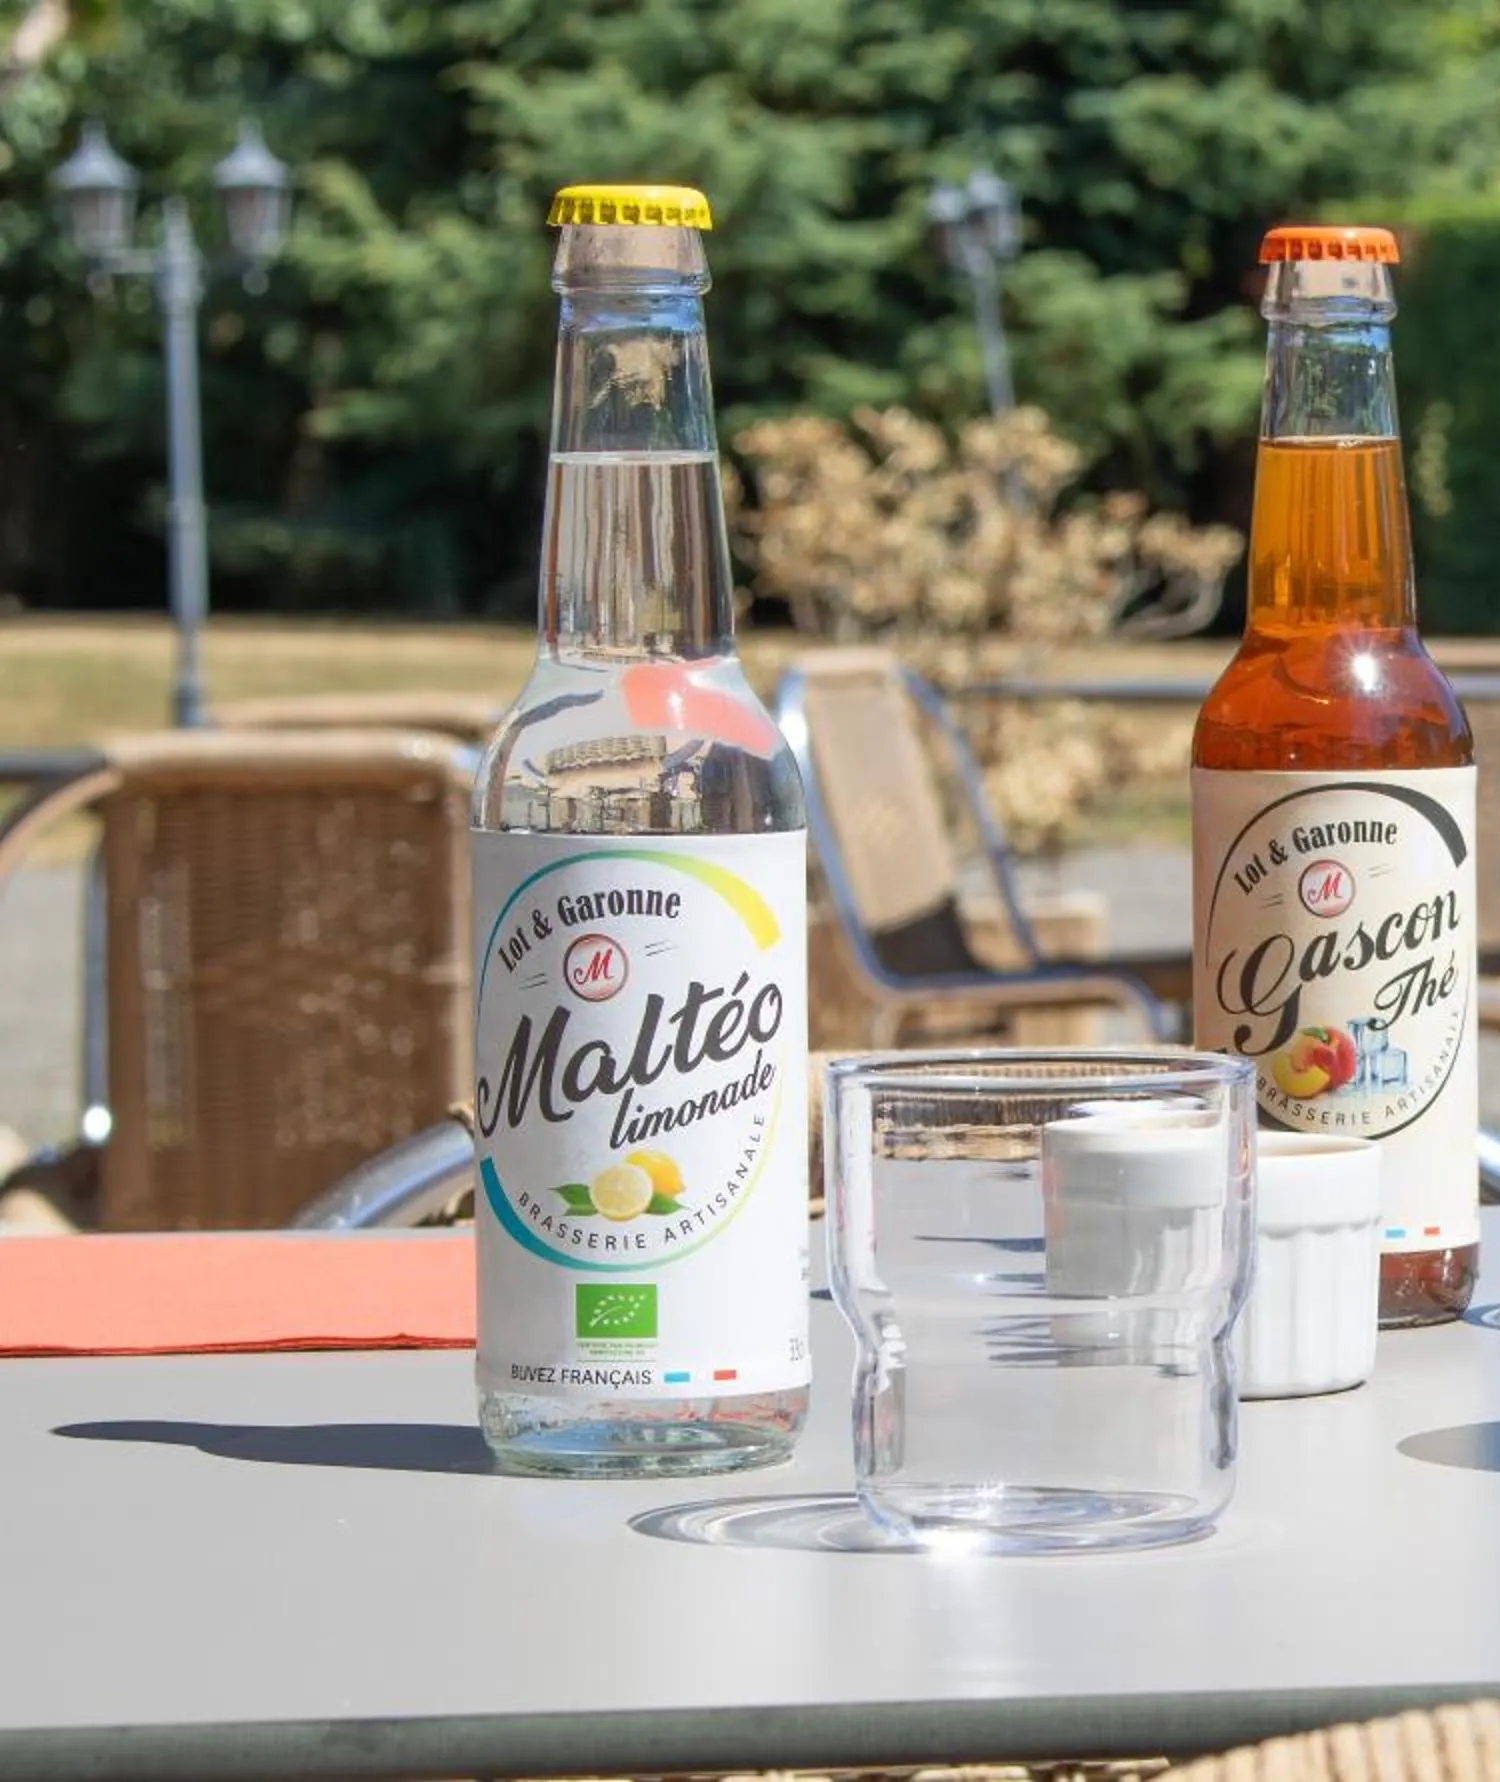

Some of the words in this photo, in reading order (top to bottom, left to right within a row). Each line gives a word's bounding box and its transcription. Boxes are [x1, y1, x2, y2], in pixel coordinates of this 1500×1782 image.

[1234, 853, 1268, 896] Lot
[1268, 839, 1289, 866] &
[1291, 819, 1398, 855] Garonne
[1307, 870, 1343, 904] M
[498, 926, 533, 973] Lot
[531, 909, 553, 940] &
[557, 888, 682, 928] Garonne
[573, 948, 615, 985] M
[1216, 889, 1461, 1056] Gascon
[1367, 950, 1458, 1032] Thé
[477, 970, 783, 1139] Maltéo
[609, 1048, 775, 1150] limonade
[1257, 1074, 1372, 1127] BRASSERIE
[517, 1191, 647, 1251] BRASSERIE
[664, 1113, 766, 1245] ARTISANALE
[511, 1363, 556, 1384] BUVEZ
[560, 1368, 653, 1391] FRANÇAIS
